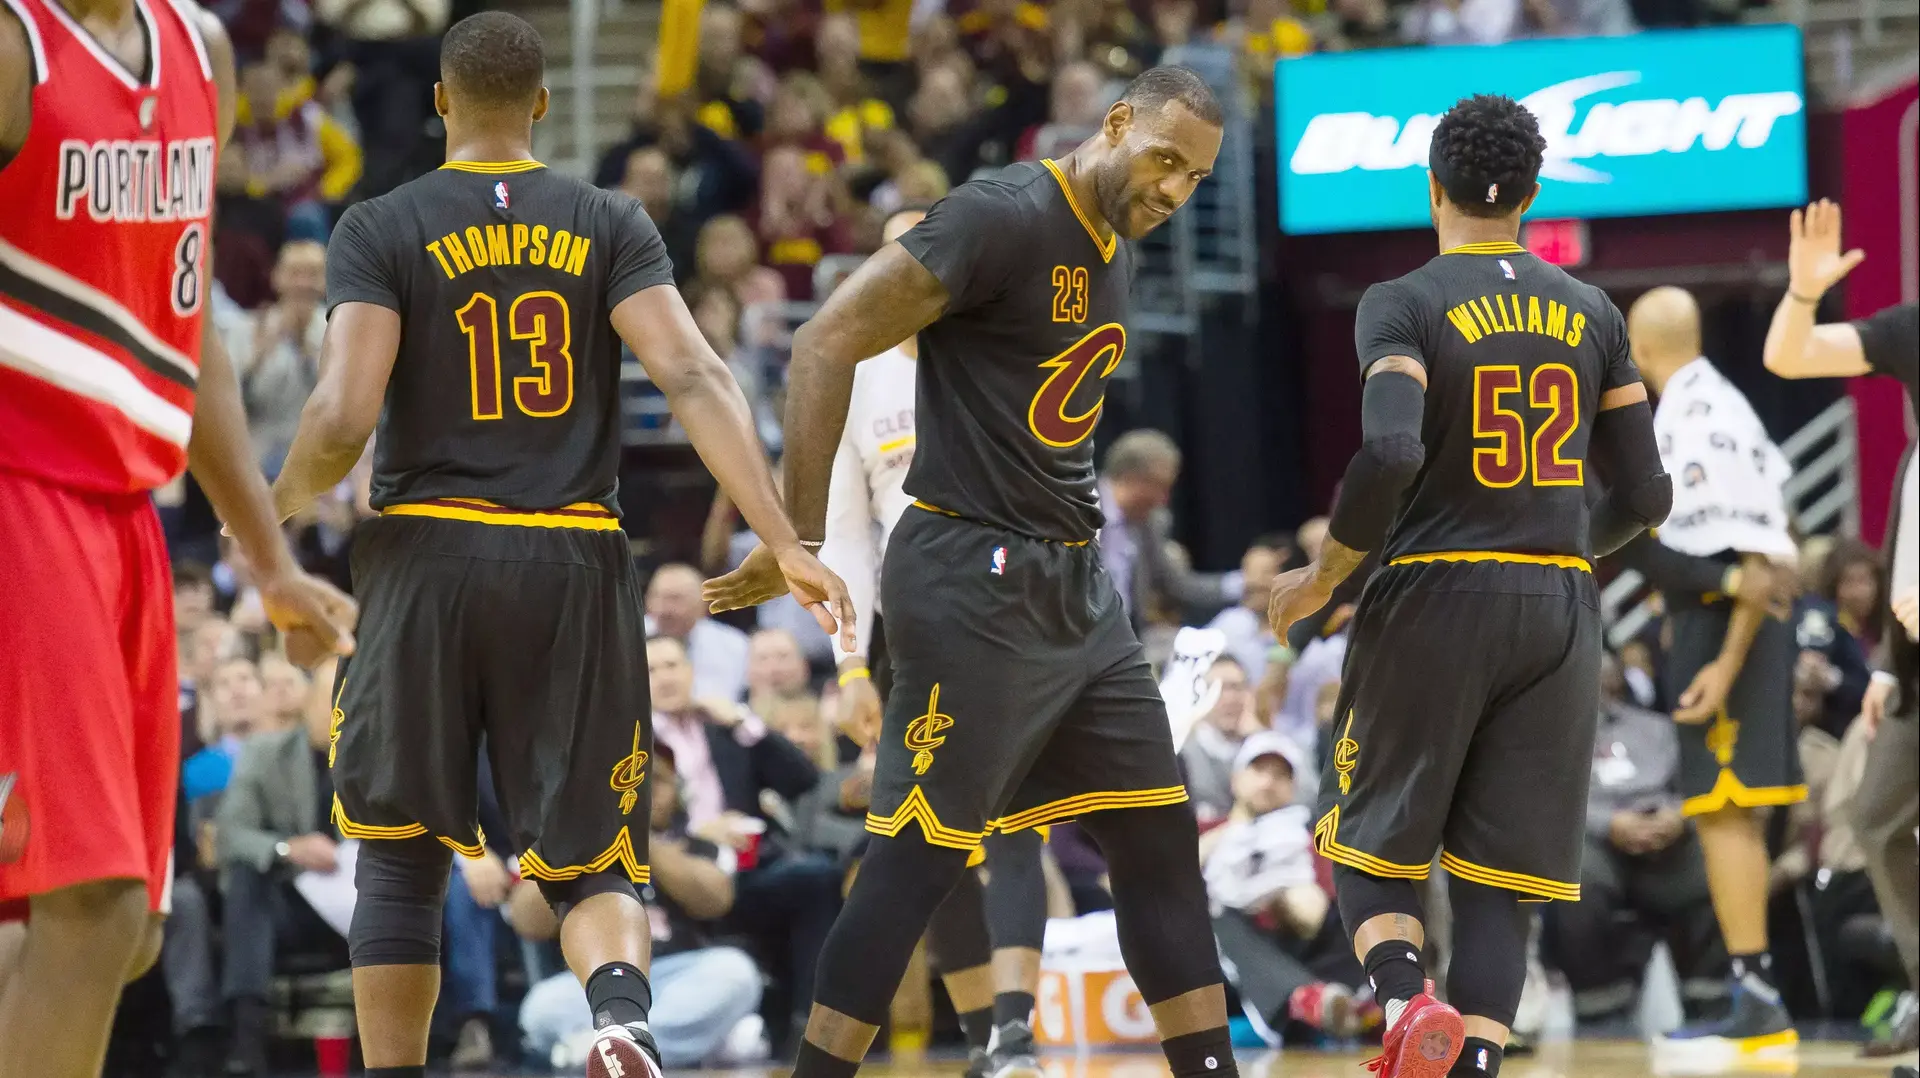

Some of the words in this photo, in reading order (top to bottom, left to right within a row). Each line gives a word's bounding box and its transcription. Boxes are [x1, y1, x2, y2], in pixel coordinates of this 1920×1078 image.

[56, 137, 215, 223] PORTLAN
[1290, 112, 1447, 175] BU
[171, 222, 205, 318] 8
[426, 224, 591, 280] THOMPSON
[1052, 265, 1089, 323] 23
[1447, 294, 1586, 347] WILLIAMS
[455, 291, 573, 420] 13
[1472, 362, 1584, 488] 52
